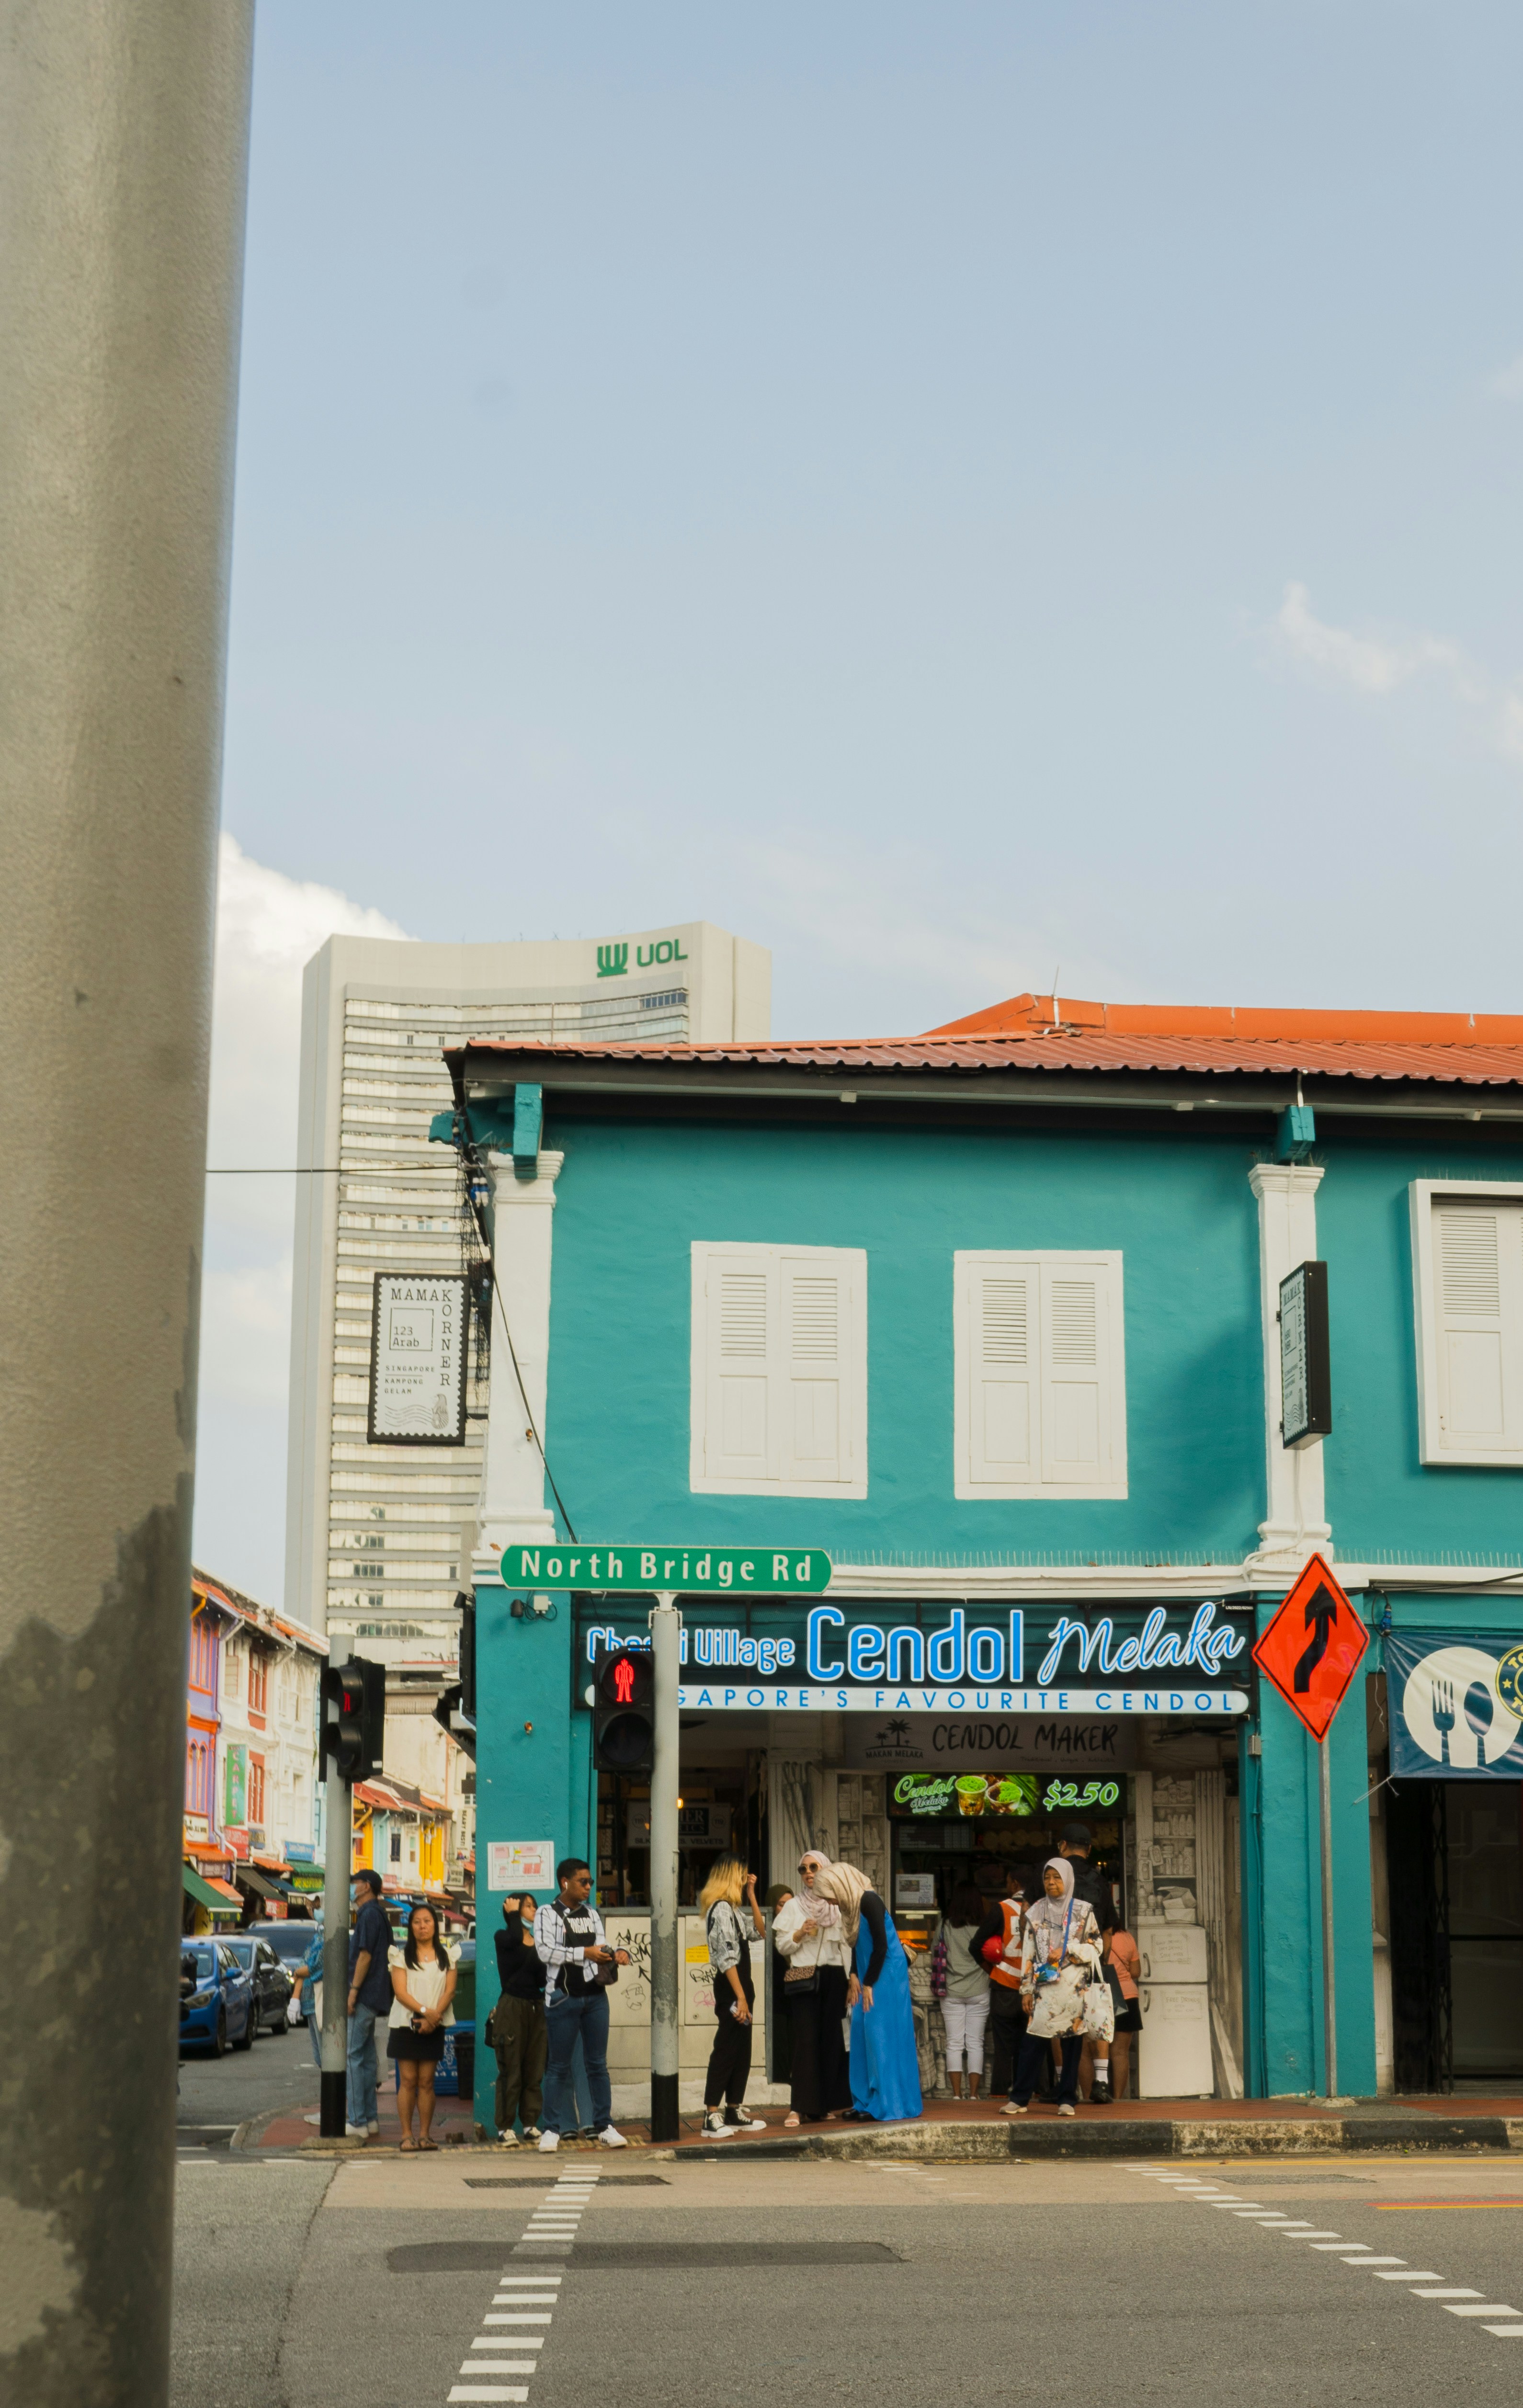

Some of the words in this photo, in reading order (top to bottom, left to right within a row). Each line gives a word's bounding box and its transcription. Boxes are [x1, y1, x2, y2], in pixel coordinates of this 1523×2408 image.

[636, 939, 688, 967] UOL
[391, 1288, 453, 1302] MAMAK
[393, 1326, 413, 1336] 123
[393, 1337, 420, 1347] Arab
[521, 1550, 623, 1579] North
[640, 1552, 754, 1588] Bridge
[773, 1555, 811, 1582] Rd
[694, 1628, 796, 1675] Village
[807, 1606, 1024, 1683] Cendol
[1037, 1602, 1246, 1685] Melaka
[875, 1691, 1068, 1710] FAVOURITE
[1096, 1692, 1232, 1712] CENDOL
[932, 1723, 1024, 1752] CENDOL
[1034, 1723, 1119, 1755] MAKER
[865, 1749, 892, 1759] MAKAN
[895, 1749, 924, 1759] MELAKA
[894, 1775, 957, 1804] Cendol
[910, 1794, 949, 1808] Melaka
[1043, 1779, 1119, 1811] $2.50
